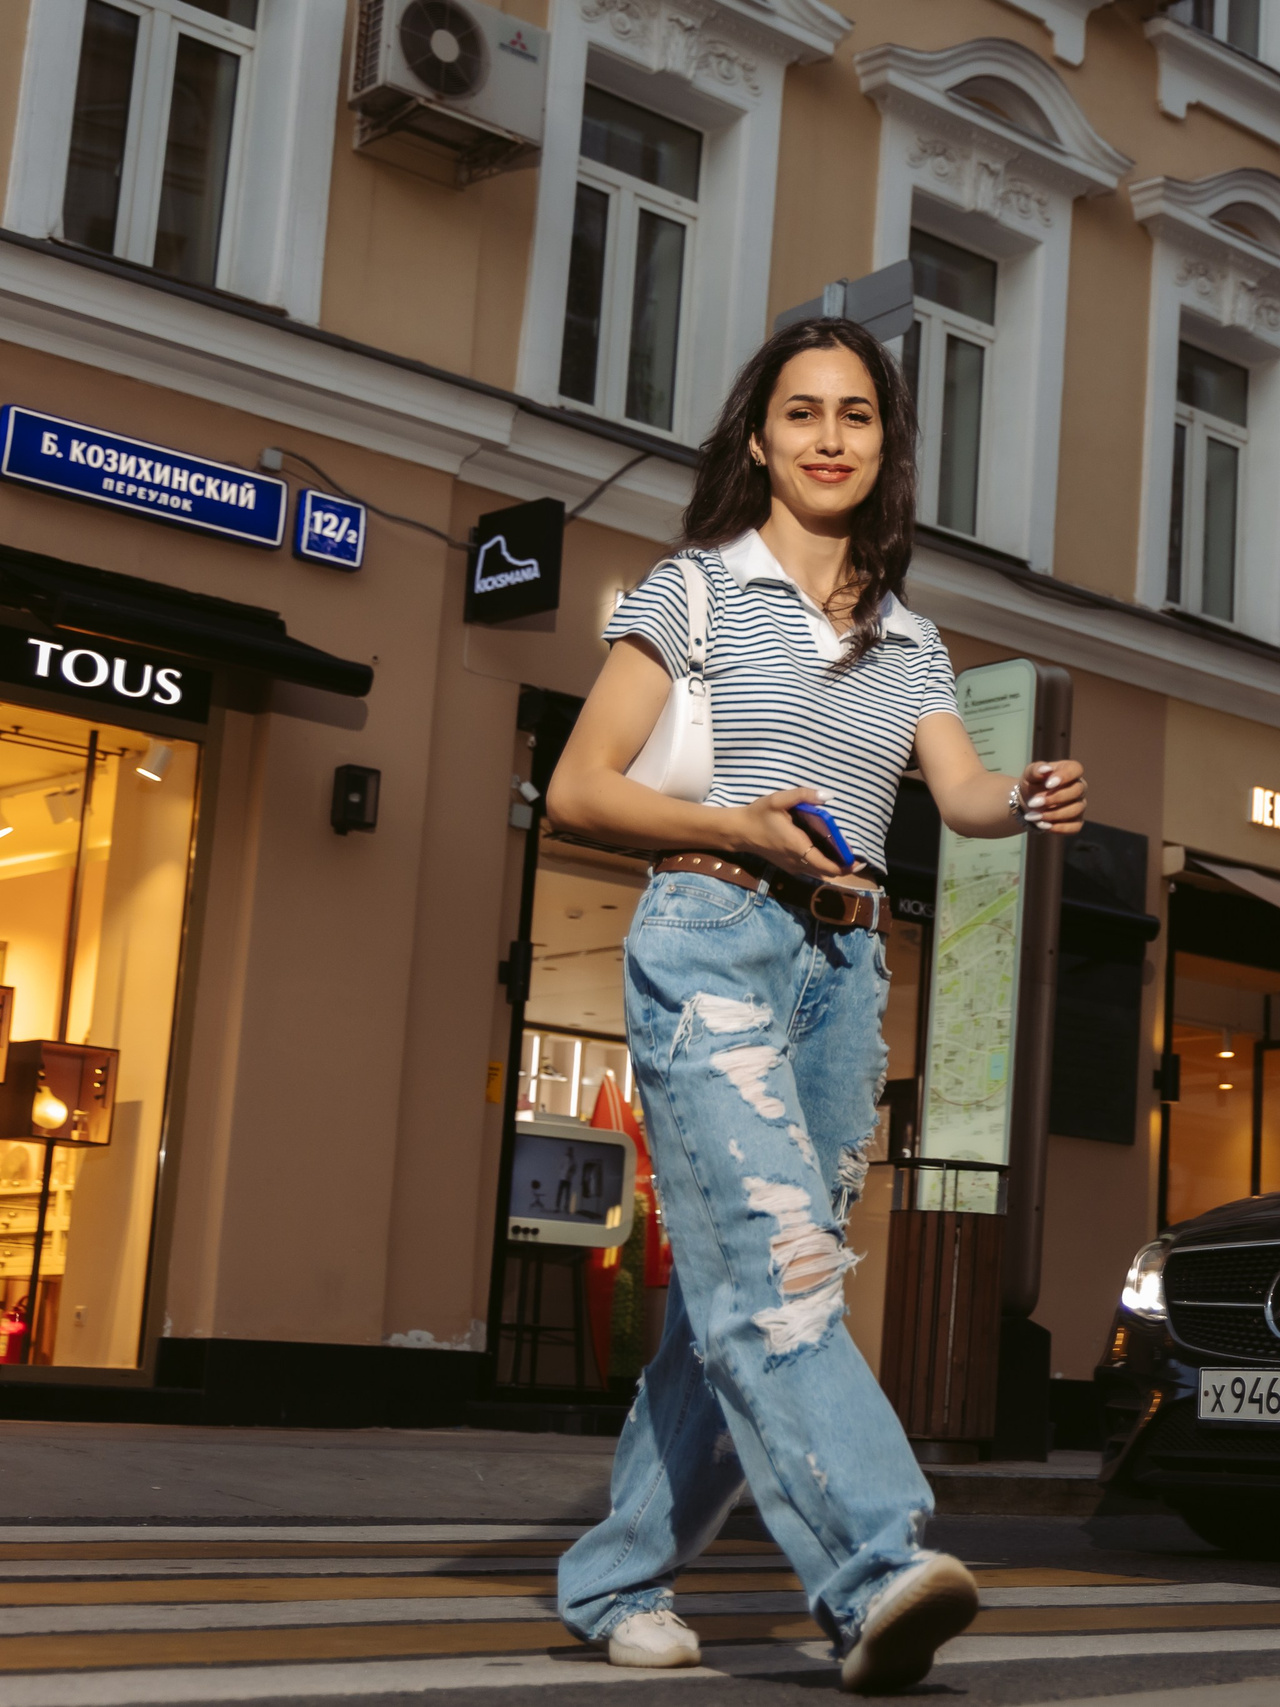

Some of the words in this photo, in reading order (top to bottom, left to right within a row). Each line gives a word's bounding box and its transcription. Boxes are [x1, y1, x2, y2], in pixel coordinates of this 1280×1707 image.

[40, 431, 64, 459] Б.
[69, 439, 257, 510] КОЗИХИНСКИЙ
[102, 477, 192, 512] ПЕРЕУЛОК
[27, 638, 182, 705] TOUS
